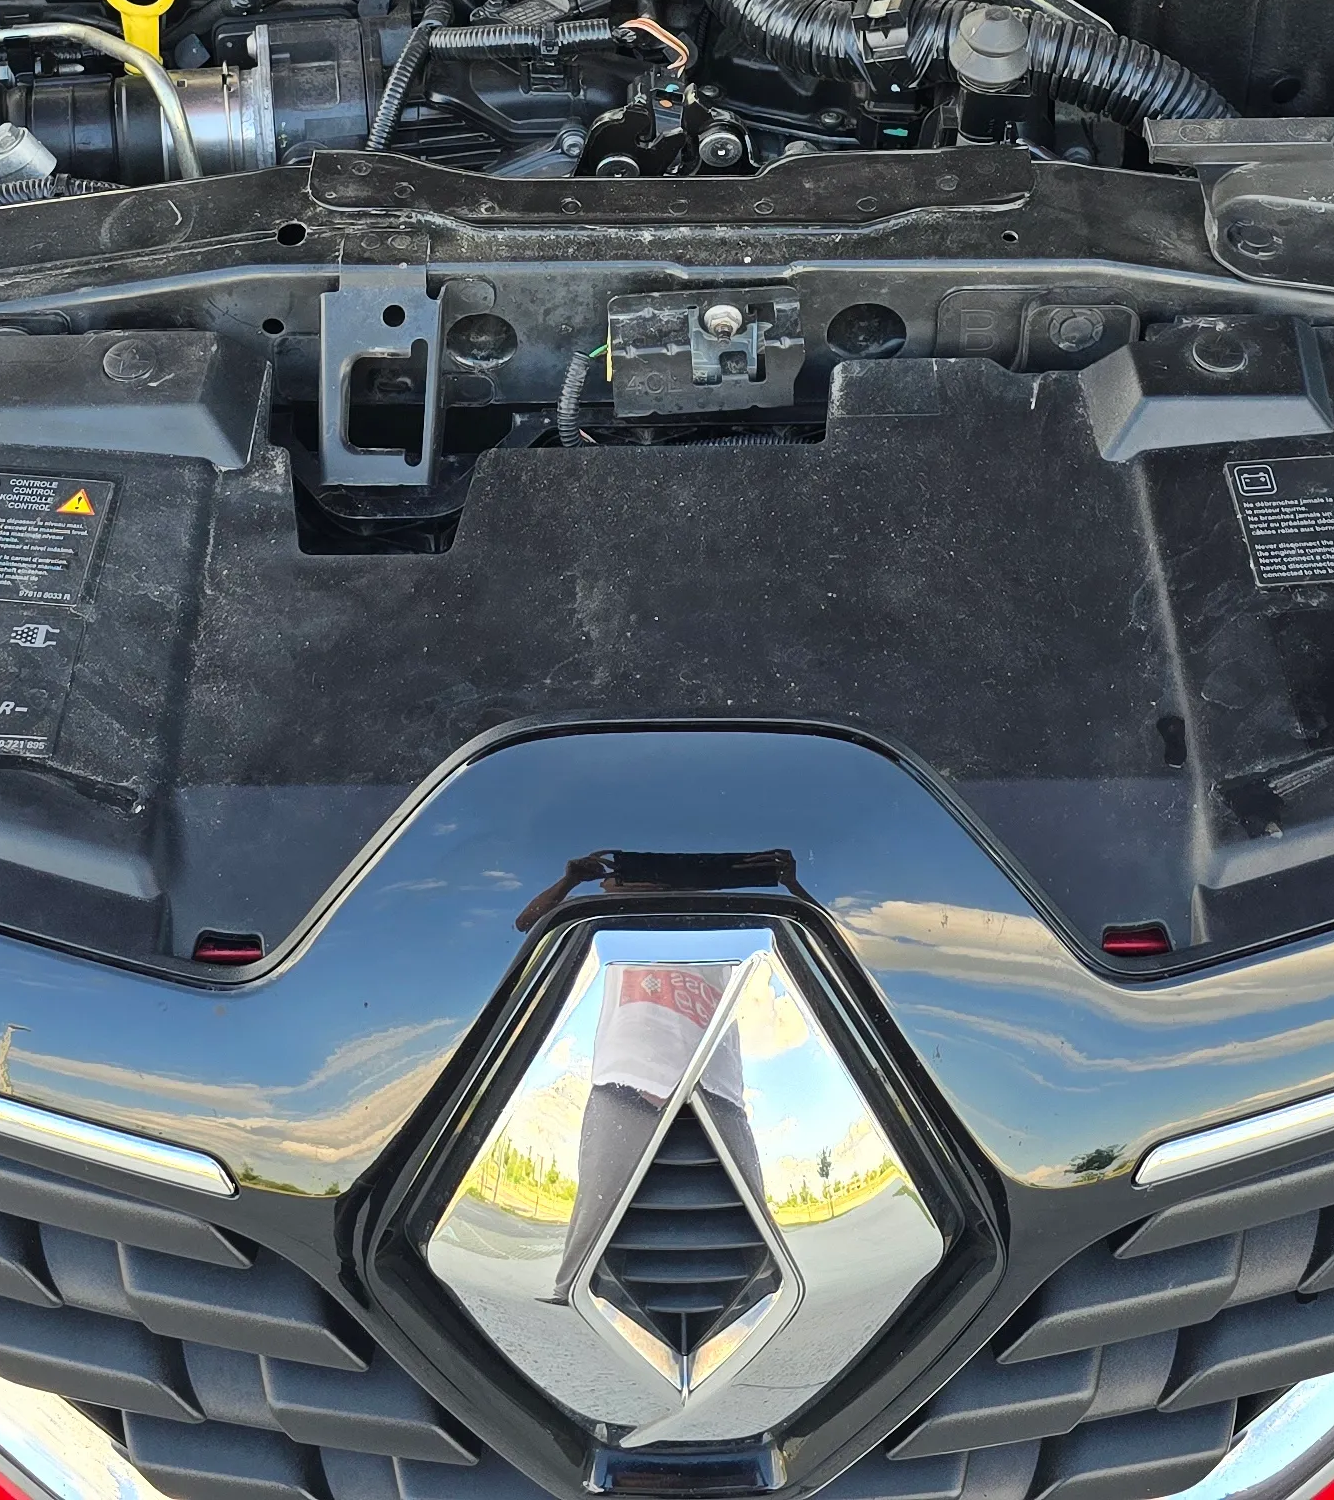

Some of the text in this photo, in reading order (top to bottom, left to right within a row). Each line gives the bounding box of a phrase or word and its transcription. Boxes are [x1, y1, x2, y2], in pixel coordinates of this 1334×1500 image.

[9, 479, 58, 487] CONTROLE
[12, 487, 56, 495] CONTROL
[0, 494, 54, 503] KONTROLLE
[7, 502, 51, 511] CONTROL
